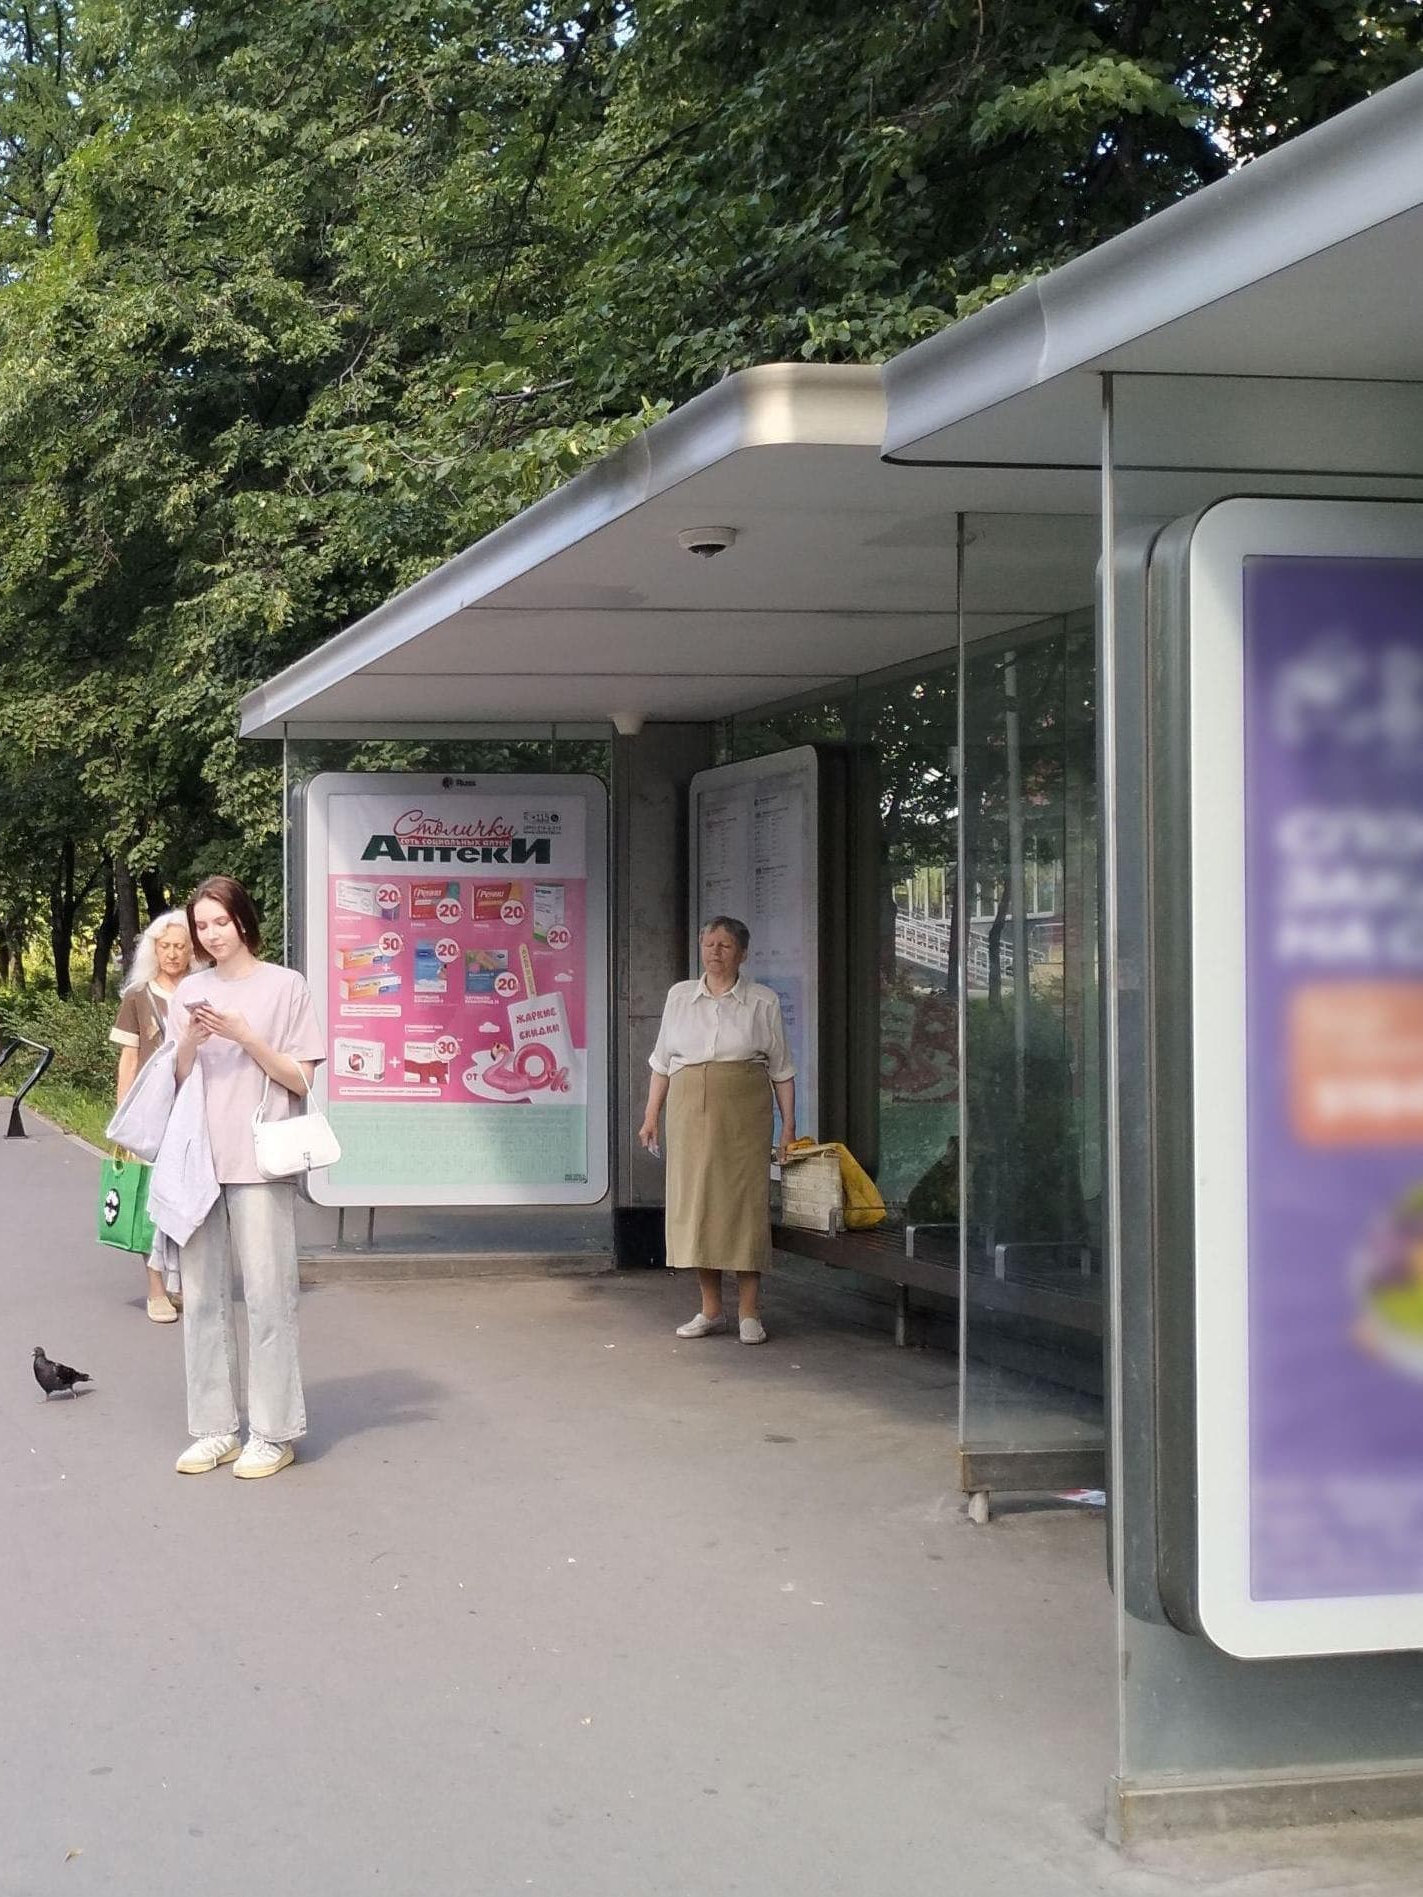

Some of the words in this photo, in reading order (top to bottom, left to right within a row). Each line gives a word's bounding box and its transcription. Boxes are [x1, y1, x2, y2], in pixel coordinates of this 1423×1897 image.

[393, 809, 518, 837] Столички
[379, 889, 398, 903] 20
[439, 904, 459, 917] 20
[503, 906, 523, 919] 20
[549, 930, 568, 943] 20
[383, 938, 399, 951] 50
[438, 944, 458, 957] 20
[498, 978, 517, 991] 20
[516, 1007, 558, 1025] ЖАРКИЕ
[438, 1041, 456, 1055] 30
